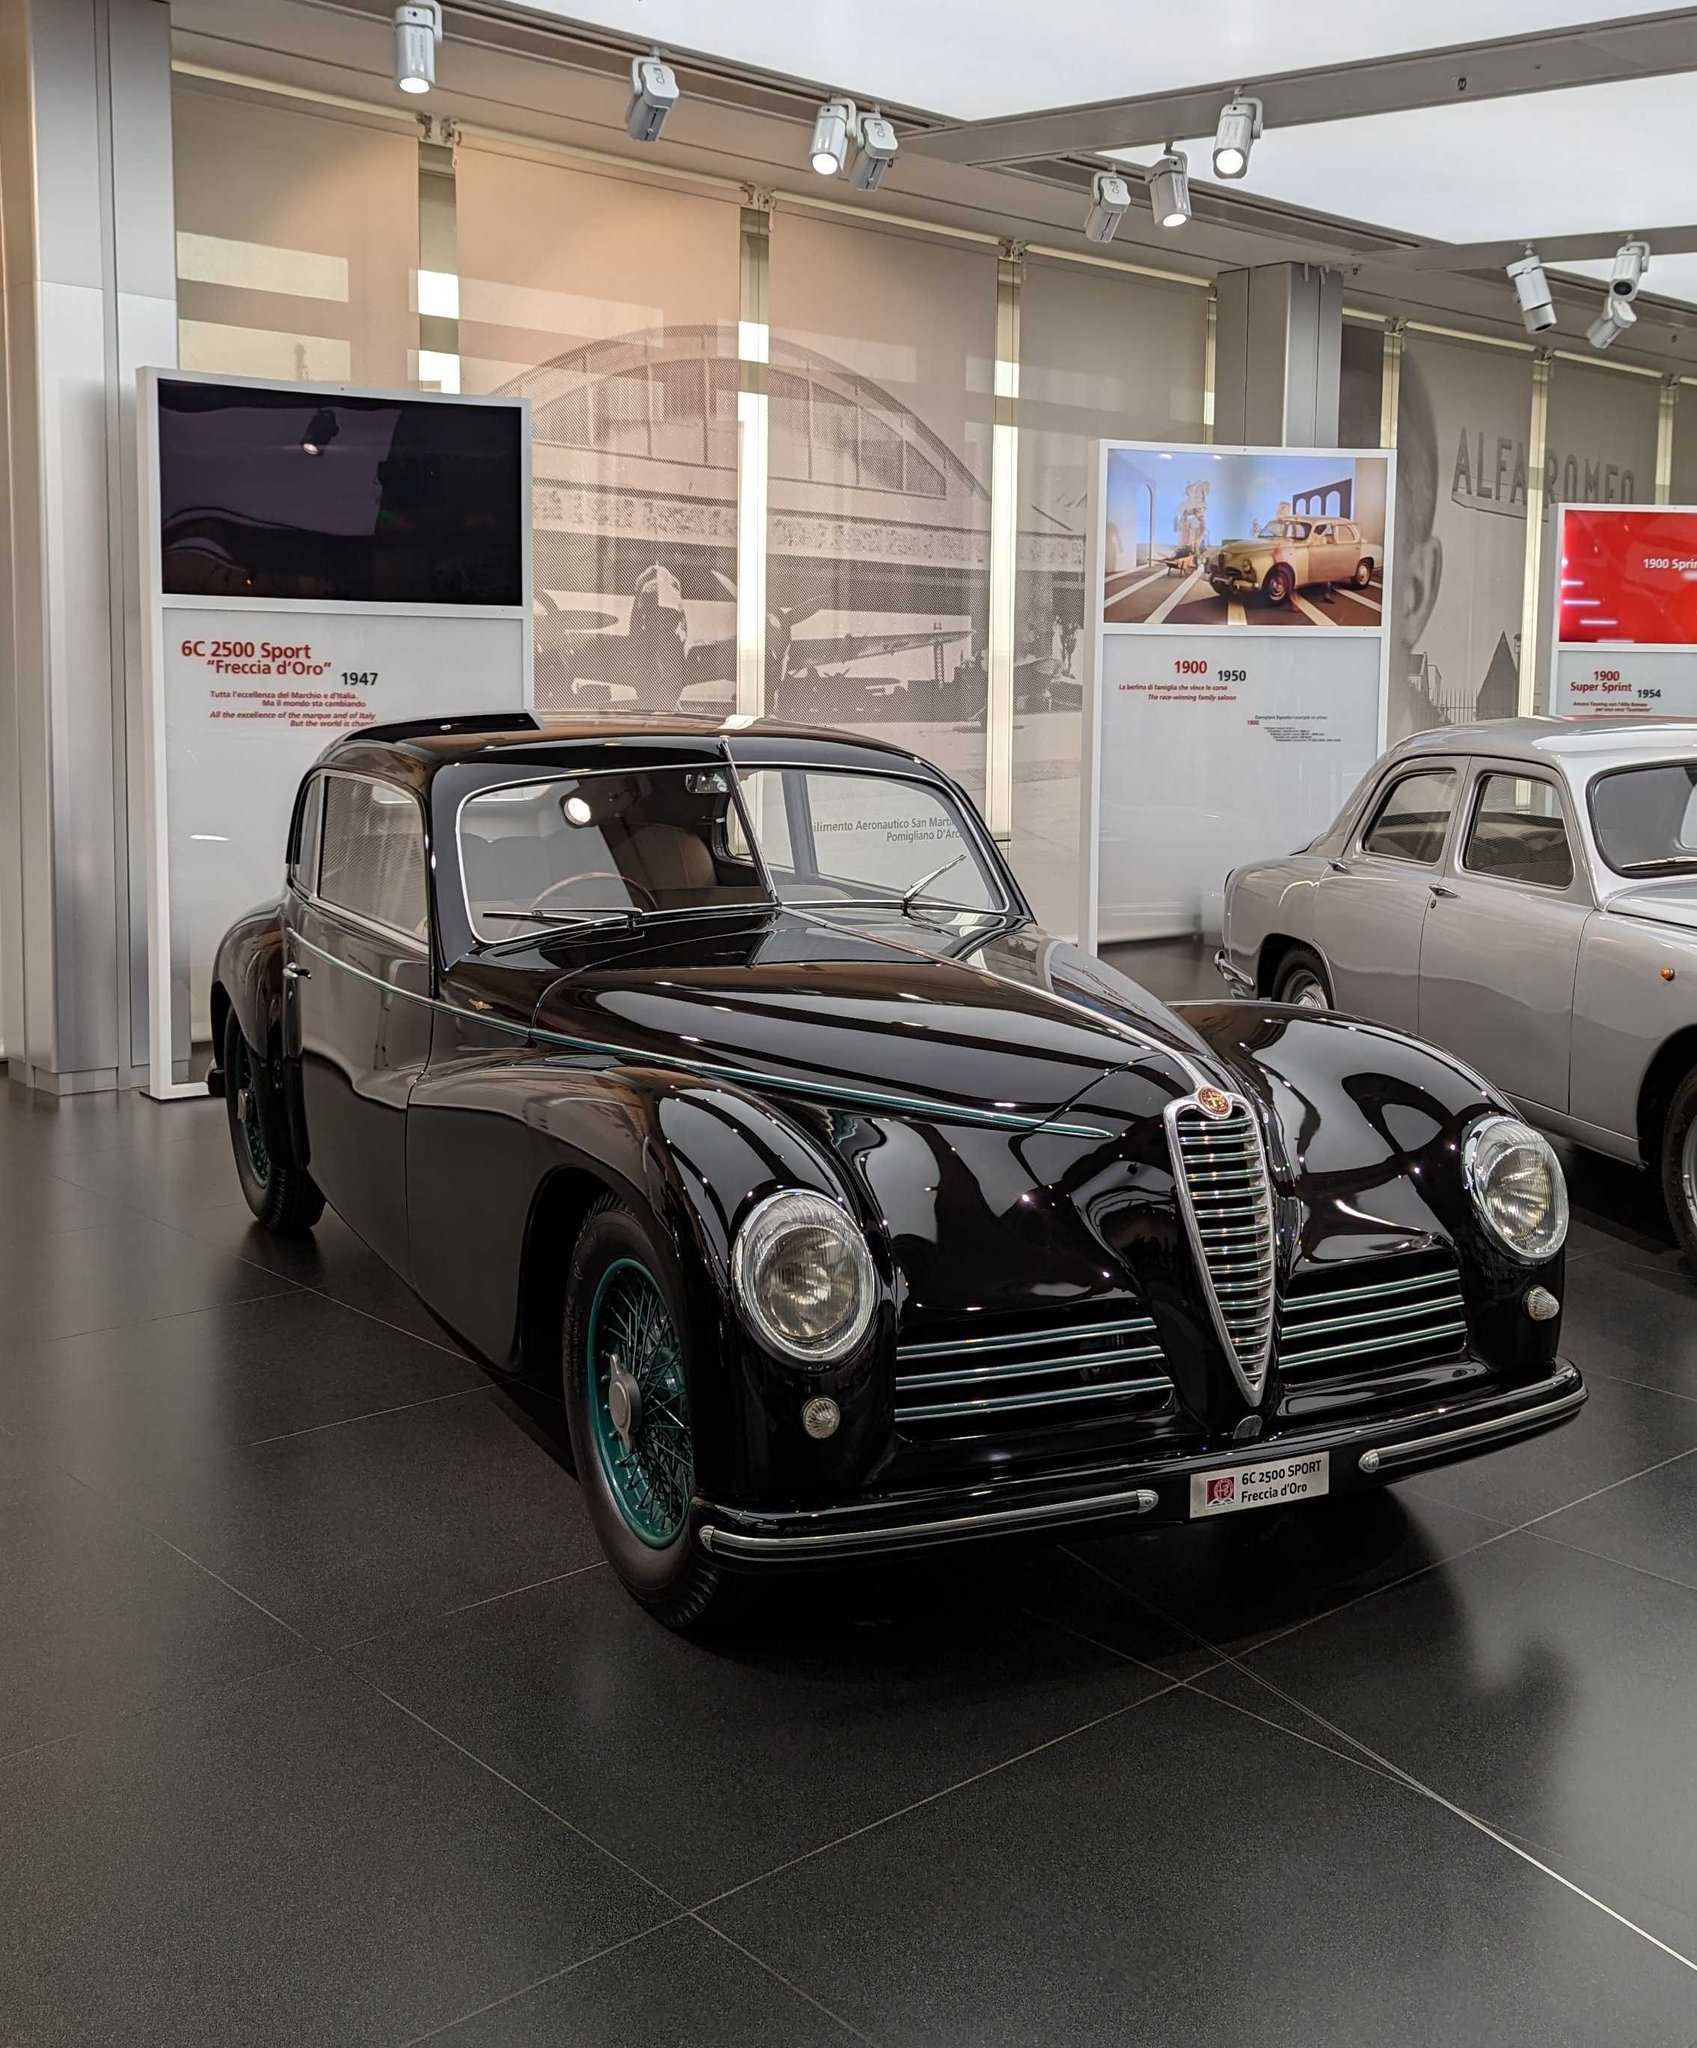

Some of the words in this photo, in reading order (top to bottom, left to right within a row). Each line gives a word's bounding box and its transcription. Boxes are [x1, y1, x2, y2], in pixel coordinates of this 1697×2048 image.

[1452, 427, 1528, 506] ALFA
[1643, 558, 1670, 569] 1900
[181, 640, 206, 657] 6C
[210, 641, 255, 658] 2500
[260, 642, 312, 662] Sport
[1173, 660, 1208, 674] 1900
[340, 672, 379, 686] 1947
[1217, 669, 1247, 682] 1950
[1593, 670, 1620, 681] 1900
[1154, 684, 1178, 692] famiglia
[1570, 682, 1599, 693] Super
[1601, 682, 1632, 693] Sprint
[1637, 689, 1661, 698] 1954
[210, 690, 231, 698] Tutta
[277, 691, 290, 699] del
[291, 691, 322, 699] Marchio
[262, 699, 275, 707] Ma
[276, 699, 282, 707] il
[283, 699, 310, 707] mondo
[277, 711, 287, 719] of
[288, 711, 301, 719] the
[302, 712, 332, 720] marque
[349, 711, 359, 719] of
[359, 712, 376, 720] Italy
[813, 820, 853, 832] ilimento
[855, 818, 910, 831] Aeronautico
[911, 818, 927, 829] San
[886, 831, 934, 843] Pomigliano
[936, 828, 960, 840] D'Arc
[1241, 1472, 1256, 1485] 6C
[1259, 1468, 1285, 1483] 2500
[1287, 1459, 1322, 1477] SPORT
[1241, 1487, 1278, 1503] Freccia
[1280, 1482, 1308, 1497] d'Oro
